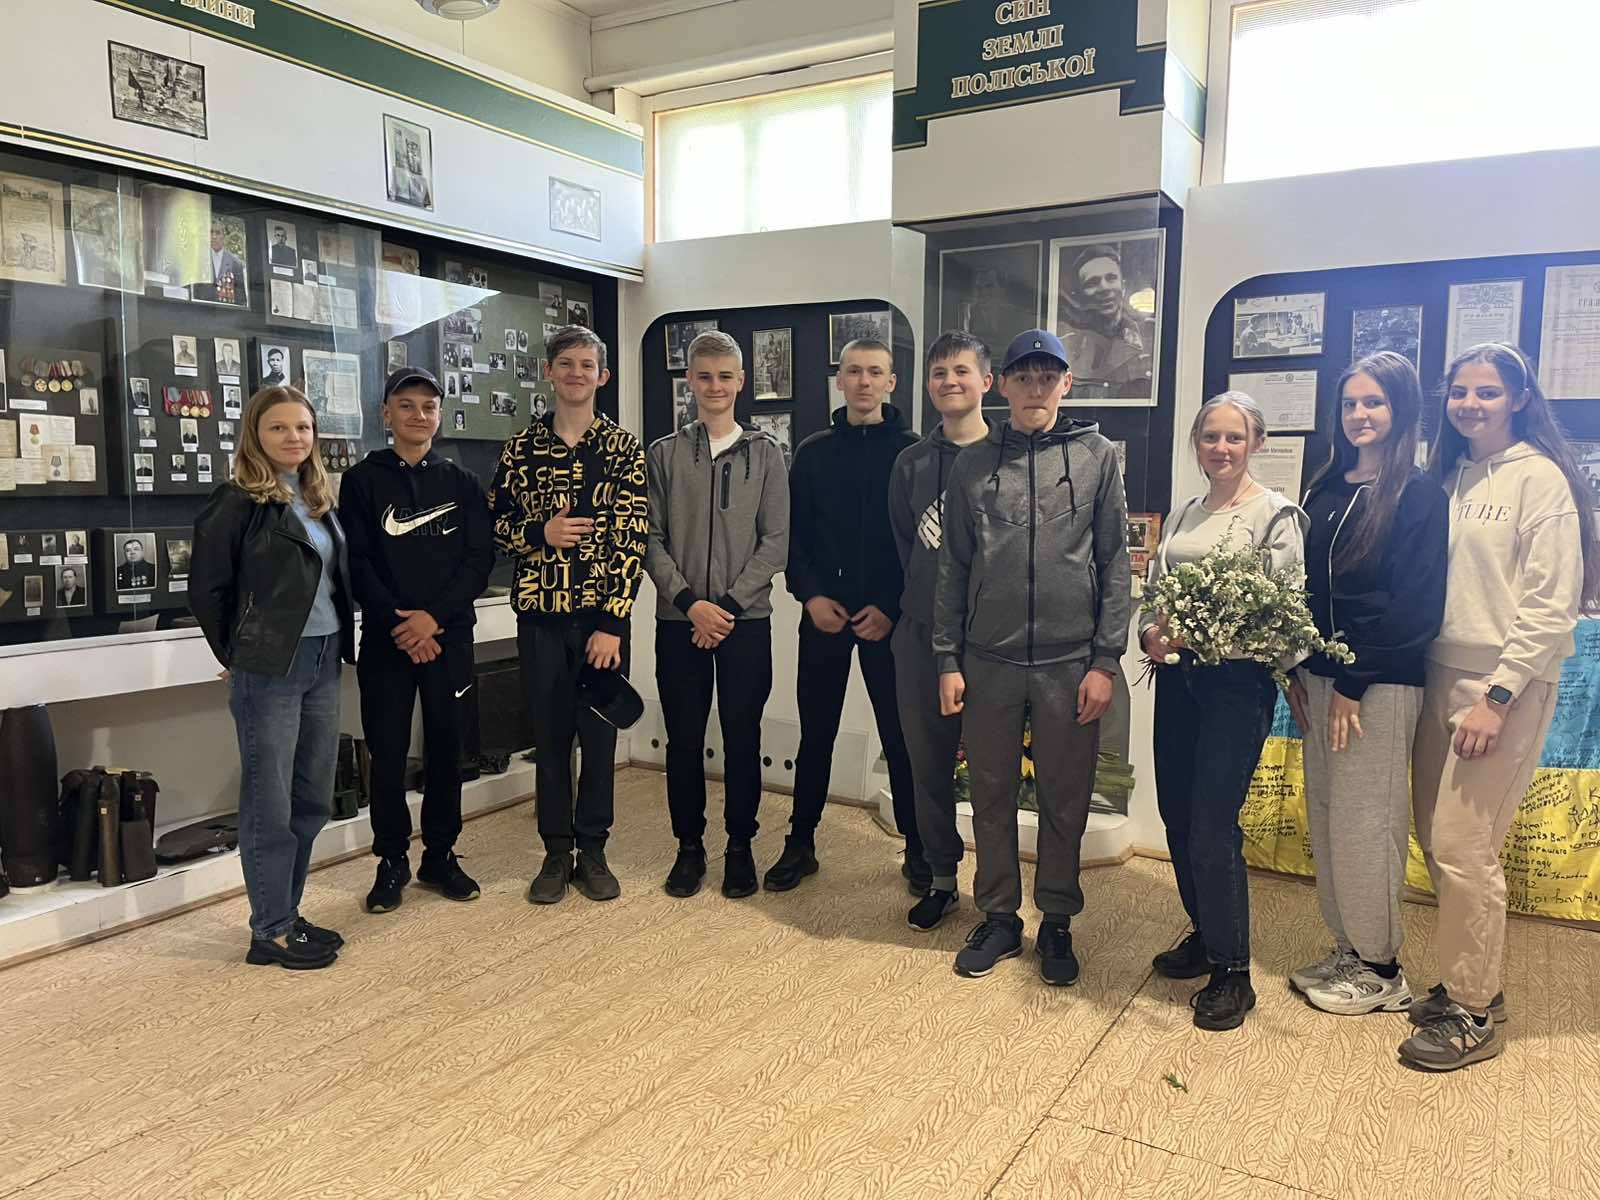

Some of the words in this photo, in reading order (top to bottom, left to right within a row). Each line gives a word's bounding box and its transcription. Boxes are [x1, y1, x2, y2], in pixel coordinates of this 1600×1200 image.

[995, 0, 1051, 24] СИН
[982, 25, 1063, 60] ЗЕМЛІ
[951, 48, 1096, 98] ПОЛІСЬКОЇ
